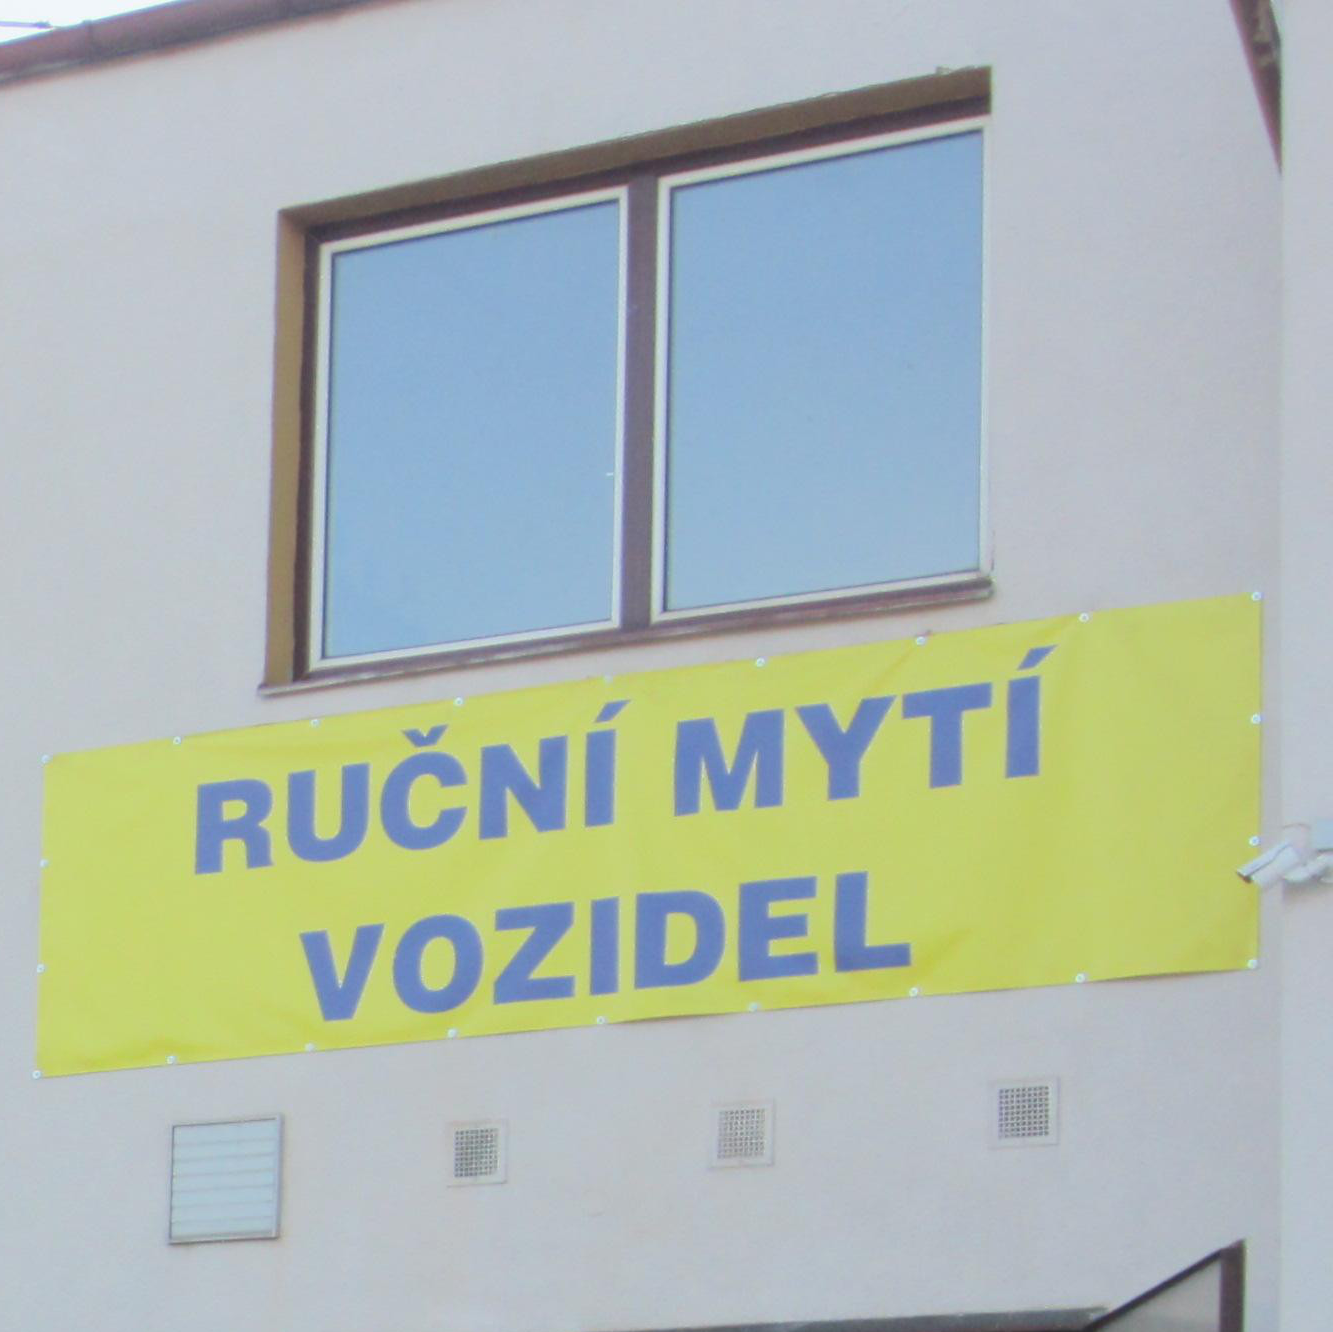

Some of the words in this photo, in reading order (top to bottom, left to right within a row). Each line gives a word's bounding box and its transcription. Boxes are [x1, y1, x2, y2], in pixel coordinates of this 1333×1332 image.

[194, 699, 630, 876] RUČNÍ
[671, 644, 1058, 815] MYTÍ
[299, 871, 912, 1022] VOZIDEL
